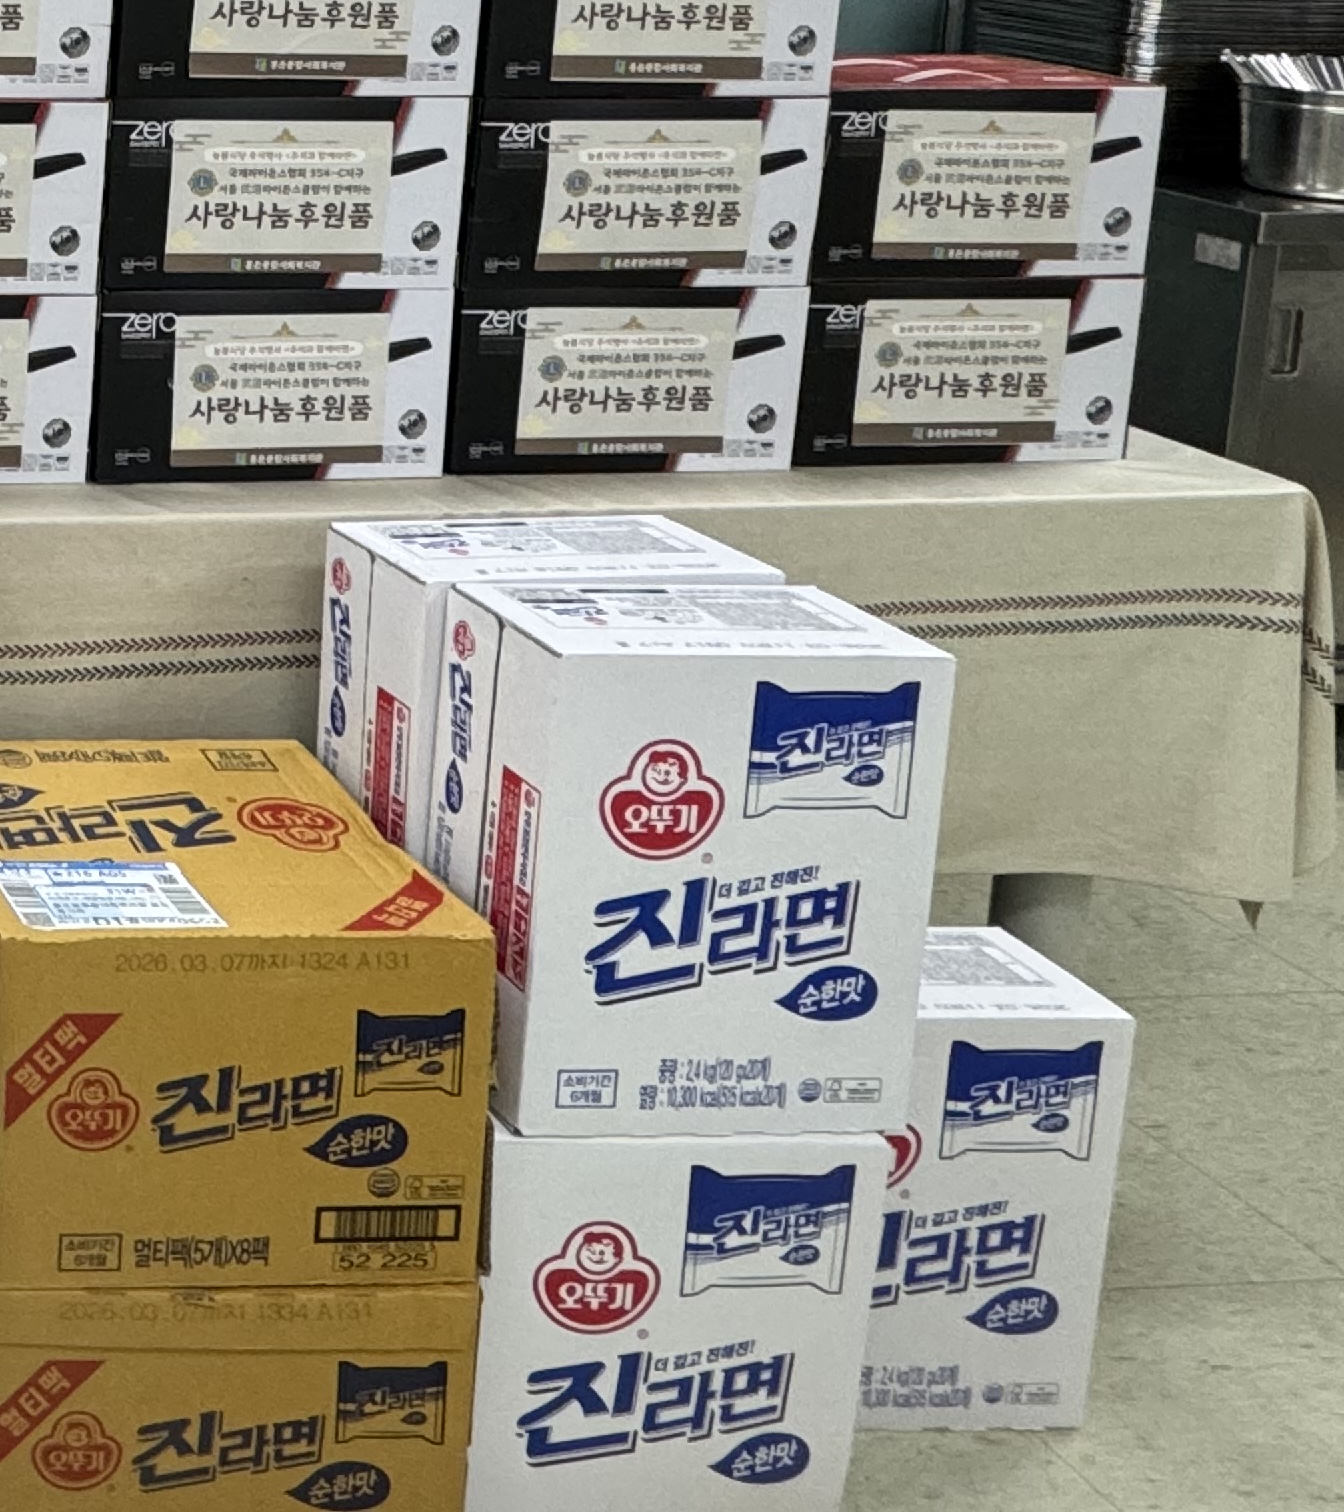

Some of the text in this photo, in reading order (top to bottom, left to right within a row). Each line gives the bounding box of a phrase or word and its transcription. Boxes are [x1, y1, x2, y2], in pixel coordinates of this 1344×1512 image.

[210, 0, 399, 30] 사랑나눔후원품
[572, 1, 754, 31] 사랑나눔후원품
[184, 201, 374, 231] 사랑나눔후원품
[558, 200, 742, 229] 사랑나눔후원품
[893, 191, 1070, 219] 사랑나눔후원품
[120, 312, 178, 340] zero
[535, 386, 714, 414] 사랑나눔후원품
[872, 372, 1048, 400] 사랑나눔후원품
[189, 394, 373, 423] 사랑나눔후원품
[776, 724, 888, 774] 진라면
[623, 804, 699, 836] 오뚜기
[585, 876, 860, 1006] 진라면
[798, 973, 867, 1014] 순한맛
[12, 1016, 87, 1094] 멀티팩
[62, 1106, 124, 1133] 오뚜기
[152, 1065, 343, 1153] 진라면
[325, 1122, 394, 1162] 순한맛
[713, 1207, 824, 1256] 진라면
[337, 1251, 430, 1271] 52 225
[557, 1282, 635, 1311] 오뚜기
[985, 1295, 1049, 1328] 순한맛
[516, 1350, 796, 1468] 진라면
[48, 1448, 107, 1473] 오뚜기
[132, 1410, 326, 1493] 진라면
[730, 1440, 799, 1478] 순한맛
